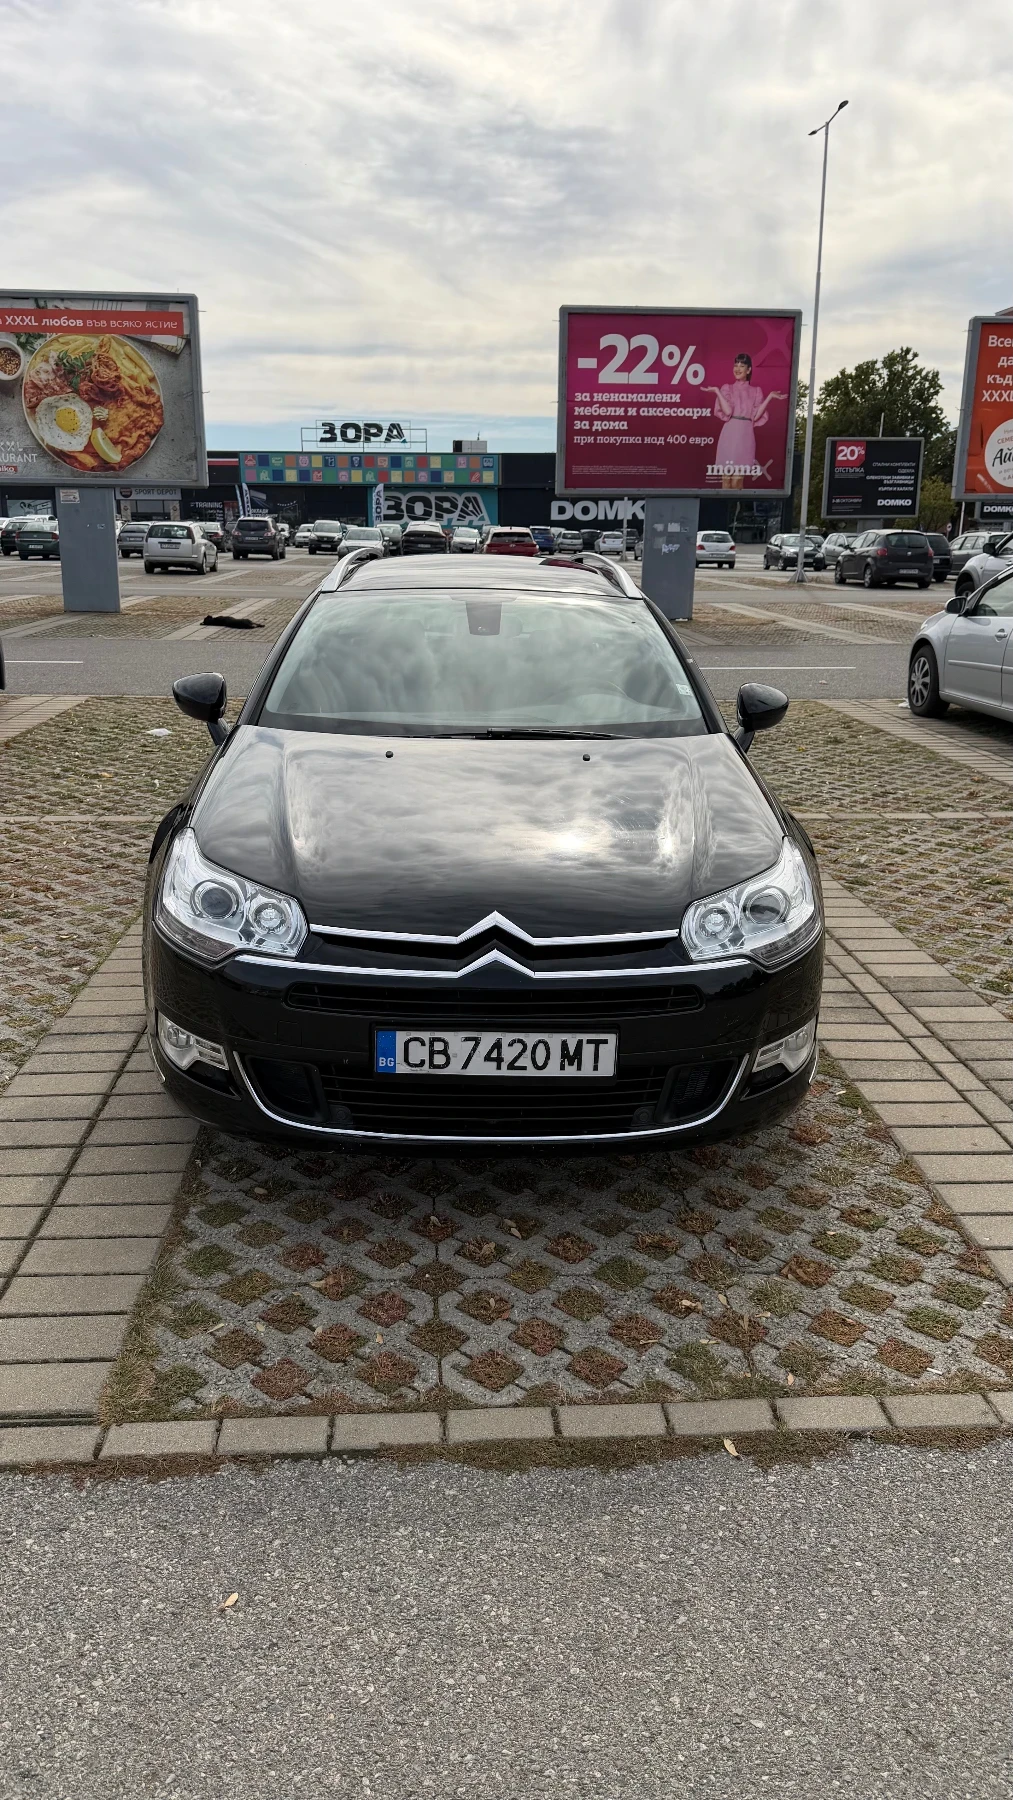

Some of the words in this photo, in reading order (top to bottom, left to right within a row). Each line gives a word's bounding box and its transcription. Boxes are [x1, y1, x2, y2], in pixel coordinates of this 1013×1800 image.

[5, 315, 38, 326] XXXL
[41, 316, 84, 327] любов
[86, 319, 108, 328] във
[110, 320, 142, 328] всяко
[145, 320, 178, 329] ястие
[987, 335, 1013, 347] Все
[577, 333, 706, 386] -22%
[574, 393, 591, 402] за
[593, 392, 681, 403] ненамалени
[573, 405, 625, 417] мебели
[627, 408, 637, 417] и
[639, 407, 711, 419] аксесоари
[573, 420, 590, 430] за
[592, 420, 628, 431] дома
[319, 422, 407, 444] ЗОРА
[573, 435, 595, 445] при
[596, 436, 642, 445] покупка
[644, 436, 665, 445] над
[666, 435, 687, 444] 400
[688, 436, 714, 446] евро
[837, 446, 865, 460] 20%
[134, 488, 156, 496] SPORT
[157, 488, 177, 496] DEPOT
[403, 1036, 451, 1070] CB
[460, 1036, 551, 1071] 7420
[559, 1038, 609, 1072] MT
[378, 1057, 395, 1067] BG
